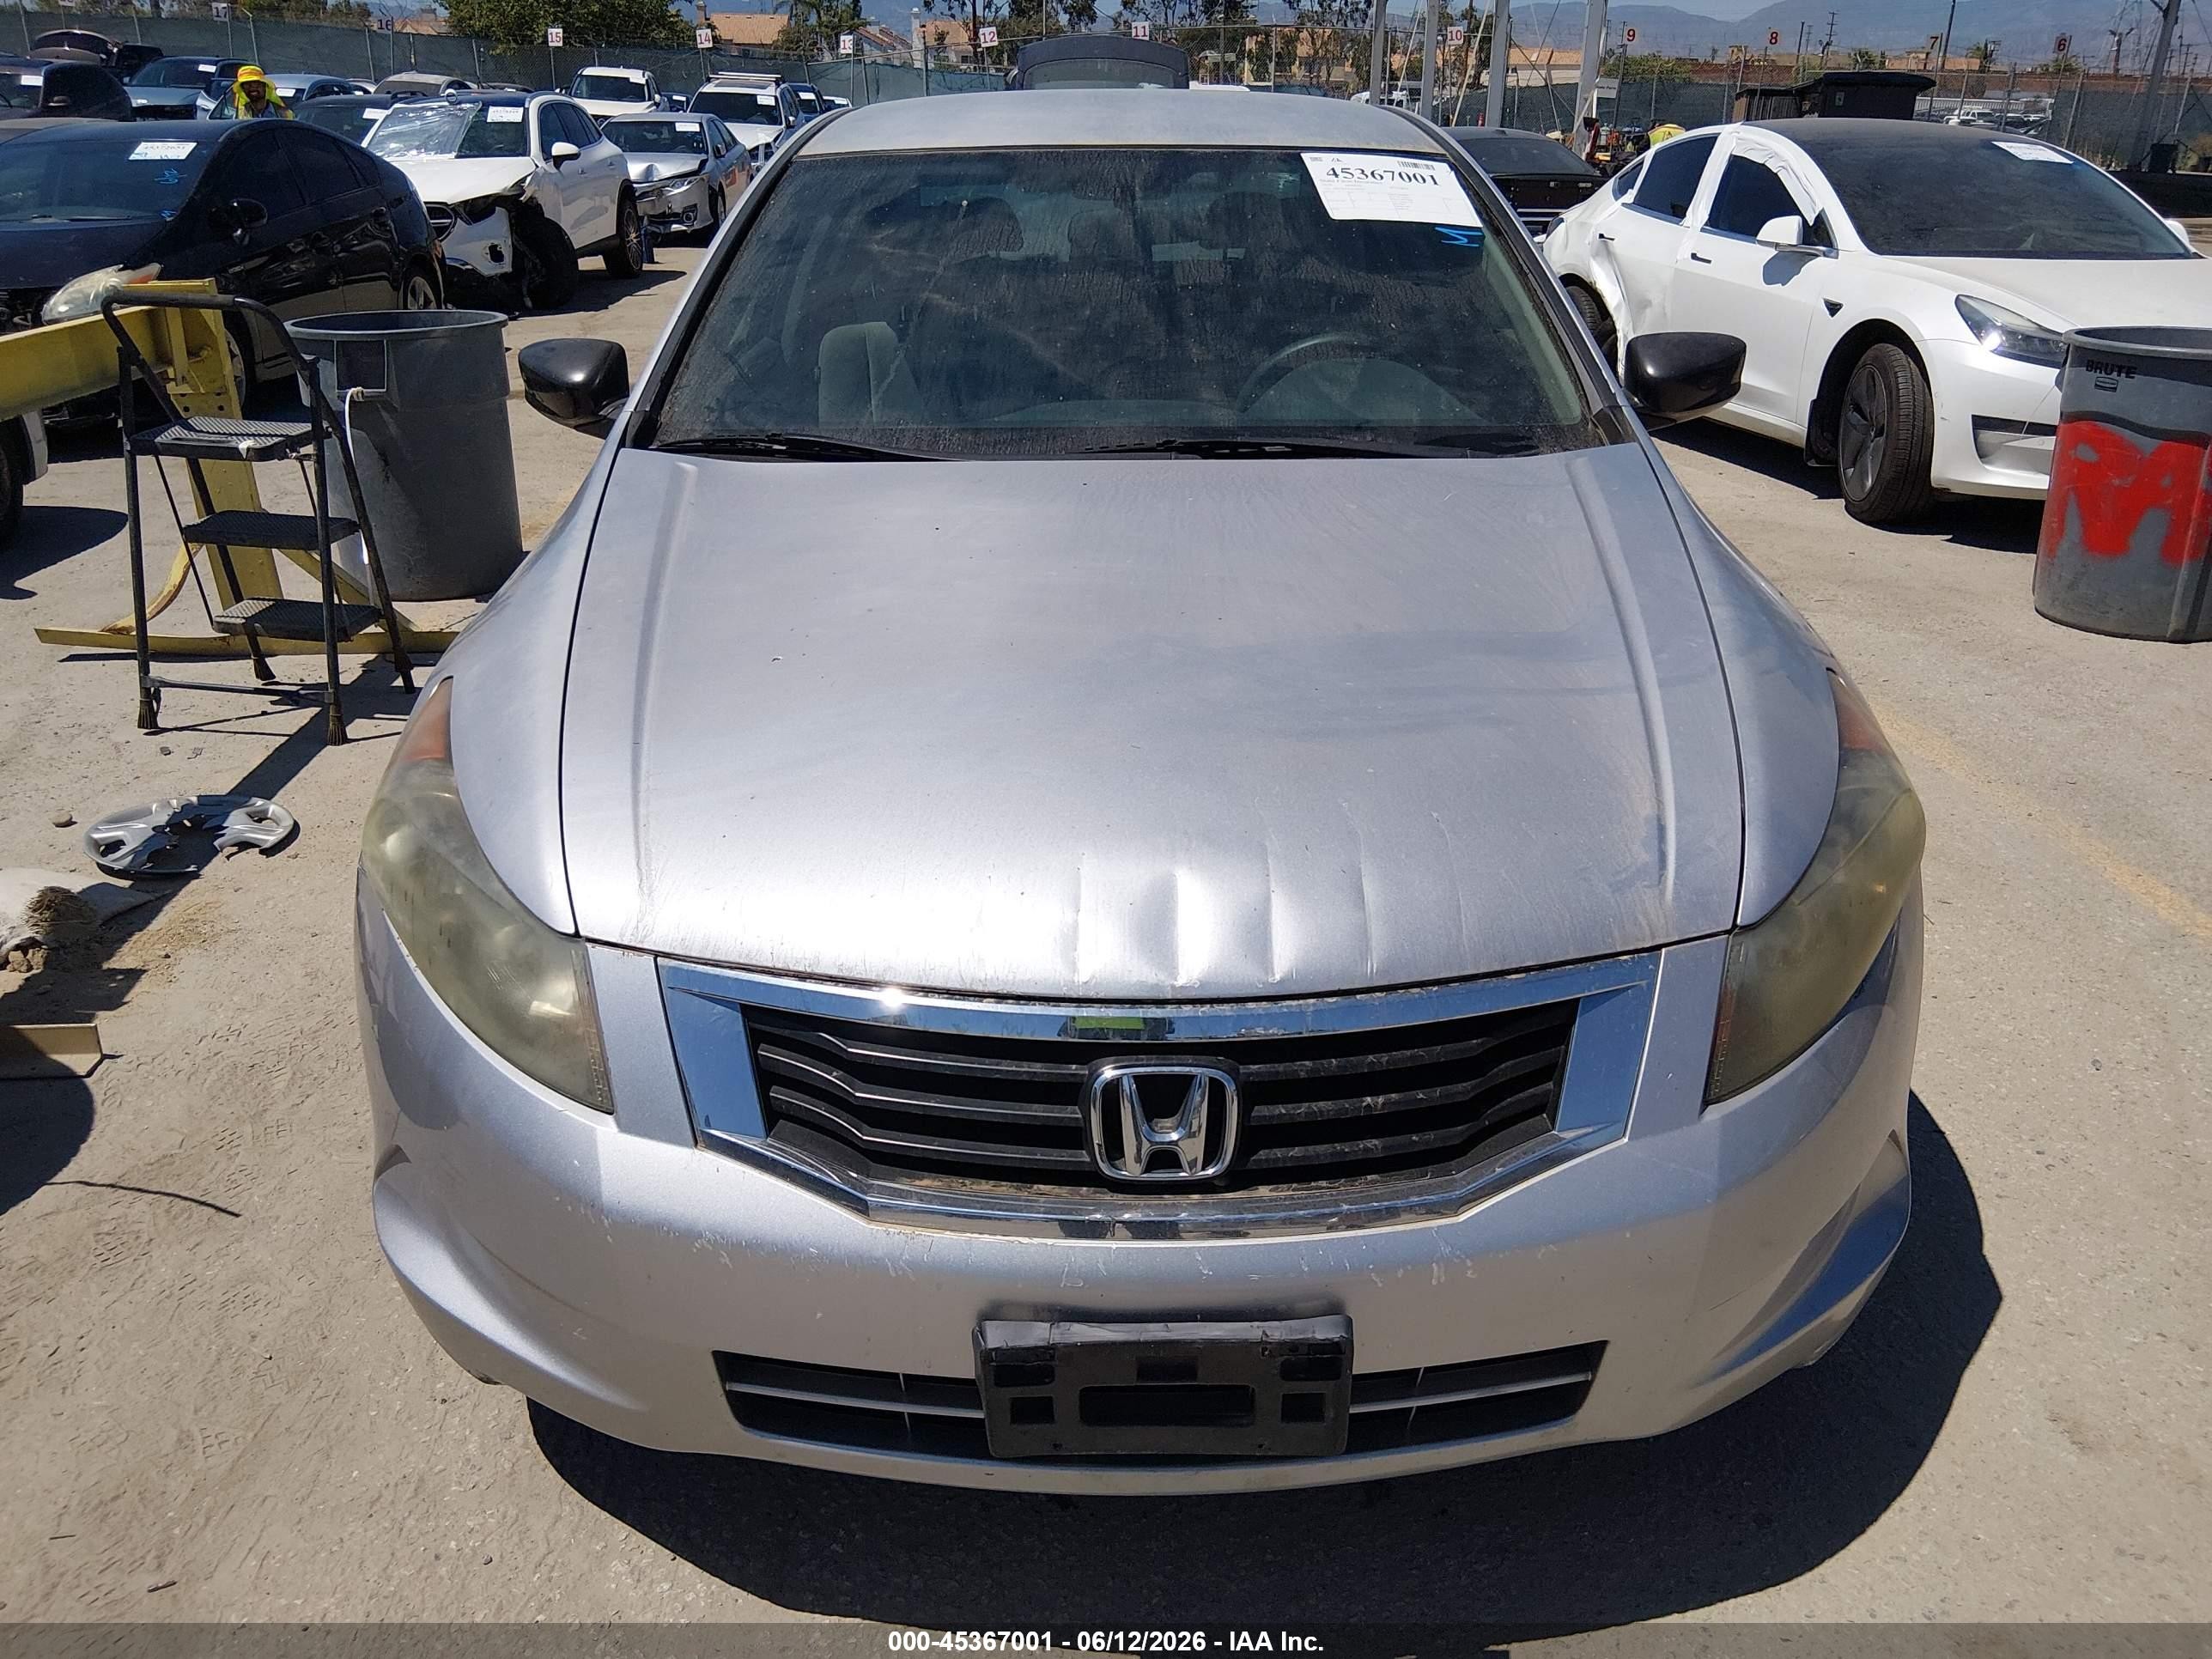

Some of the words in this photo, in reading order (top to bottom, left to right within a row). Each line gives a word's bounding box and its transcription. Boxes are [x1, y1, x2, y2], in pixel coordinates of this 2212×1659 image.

[214, 6, 228, 18] 17
[377, 19, 392, 31] 16
[1133, 25, 1148, 38] 11
[549, 32, 562, 43] 15
[698, 32, 711, 46] 14
[981, 31, 996, 44] 12
[1448, 29, 1462, 41] 10
[1626, 28, 1636, 42] 9
[1769, 31, 1779, 45] 8
[1929, 36, 1939, 50] 7
[2057, 38, 2067, 52] 6
[1326, 166, 1440, 186] 45367001
[2086, 359, 2137, 380] BRUTE
